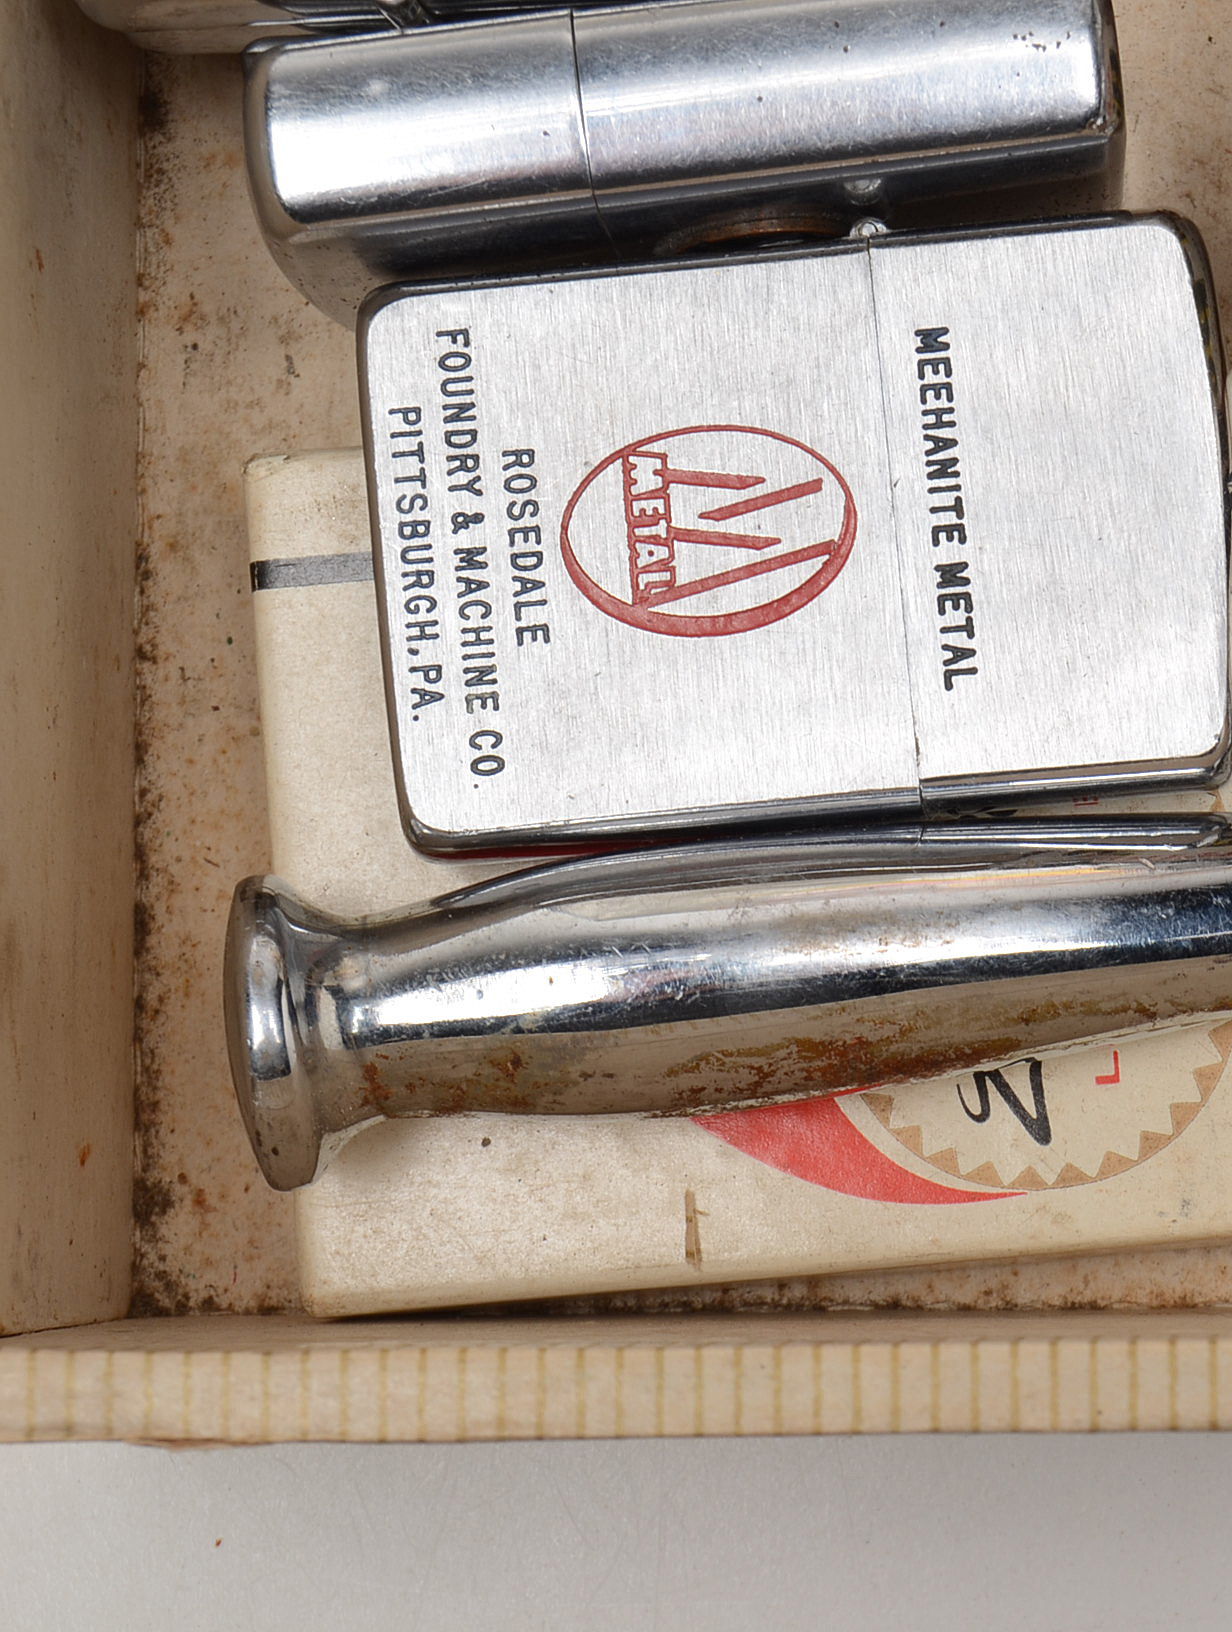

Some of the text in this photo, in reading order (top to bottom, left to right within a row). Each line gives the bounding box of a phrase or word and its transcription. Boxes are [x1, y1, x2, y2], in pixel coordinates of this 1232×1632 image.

[435, 328, 506, 789] FOUNDRY & MACHINE CO.
[502, 448, 550, 647] ROSEDALE
[622, 449, 678, 600] METAL
[914, 326, 978, 691] MEEHANITE METAL
